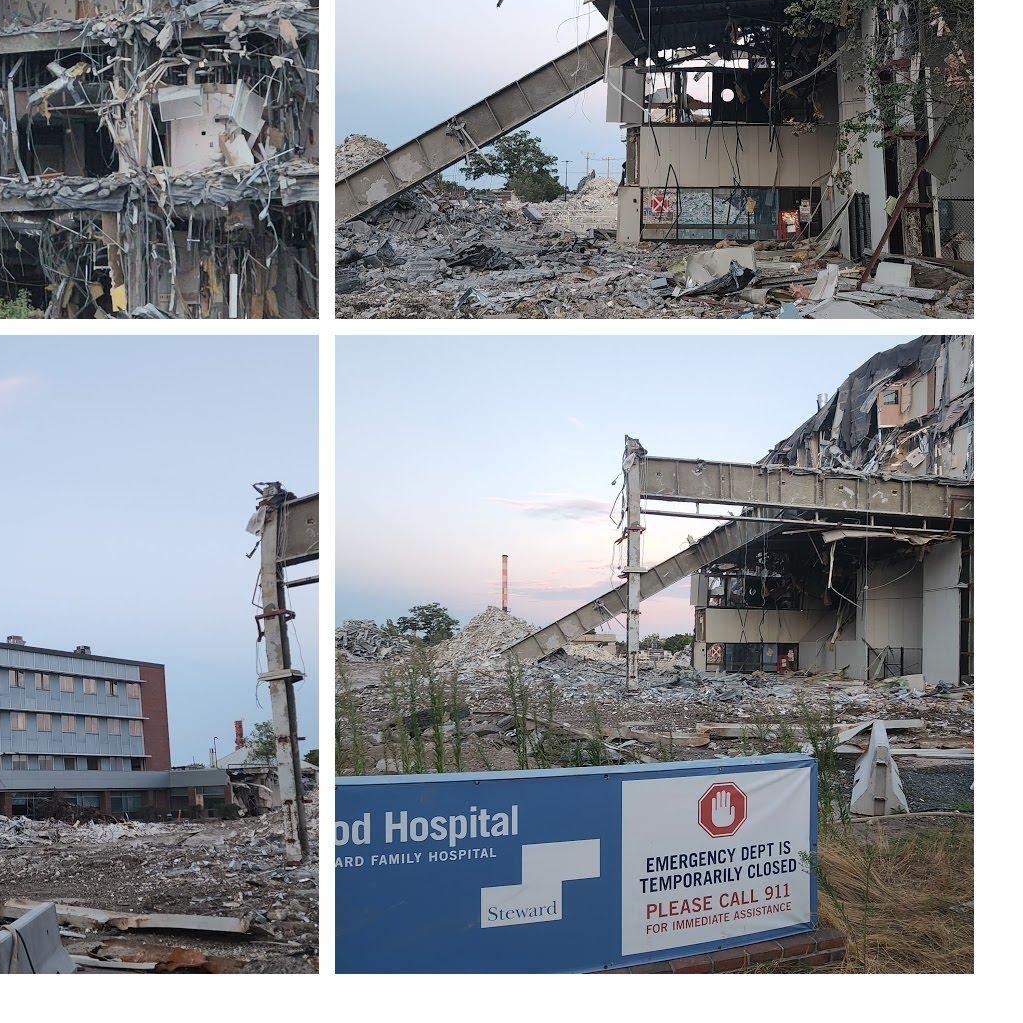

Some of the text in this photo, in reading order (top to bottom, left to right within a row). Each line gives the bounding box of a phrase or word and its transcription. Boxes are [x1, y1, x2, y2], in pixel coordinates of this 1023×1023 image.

[385, 804, 518, 847] Hospital
[335, 847, 497, 868] ARD FAMILY HOSPITAL
[646, 840, 791, 873] EMERGENCY DEPT IS
[640, 858, 797, 894] TEMPORARILY CLOSED
[487, 900, 557, 922] Steward
[646, 883, 790, 920] PLEASE CALL 911
[646, 901, 792, 935] FOR IMMEDIATE ASSISTANCE
